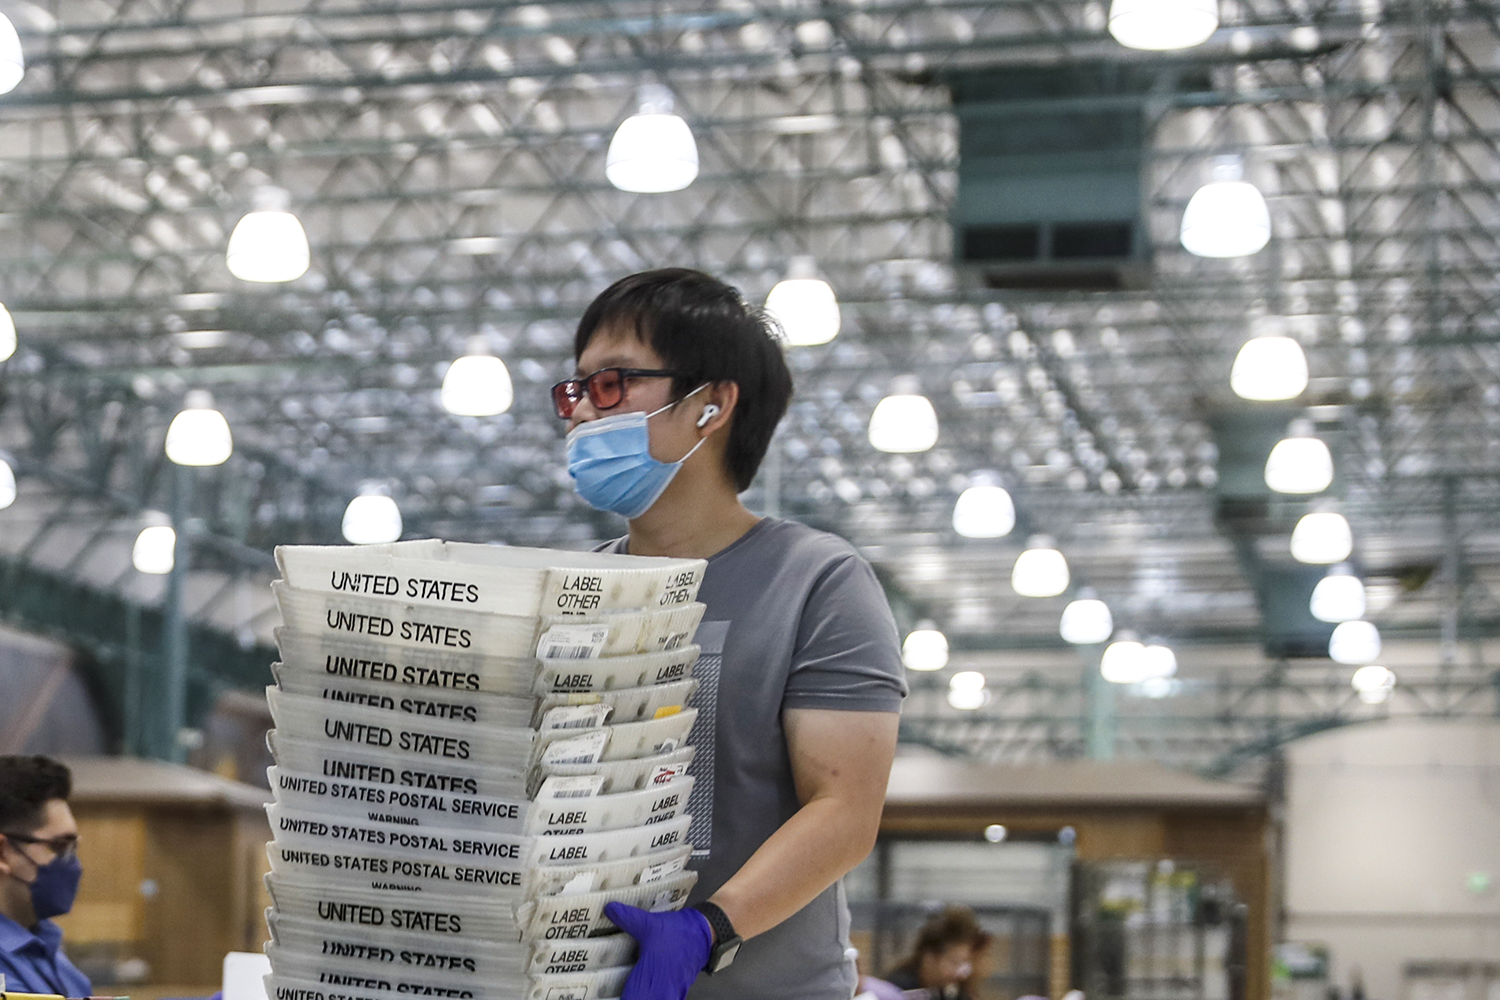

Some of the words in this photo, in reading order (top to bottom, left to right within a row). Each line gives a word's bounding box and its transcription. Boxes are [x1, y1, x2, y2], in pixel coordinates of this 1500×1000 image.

[331, 571, 399, 595] UNITED
[406, 578, 479, 603] STATES
[563, 575, 603, 592] LABEL
[665, 571, 695, 590] LABEL
[557, 594, 601, 609] OTHER
[327, 609, 394, 637] UNITED
[400, 621, 471, 648] STATES
[326, 655, 397, 681] UNITED
[402, 666, 480, 690] STATES
[656, 663, 685, 680] LABEL
[554, 674, 593, 688] LABEL
[324, 718, 392, 747] UNITED
[399, 731, 470, 759] STATES
[323, 759, 395, 784] UNITED
[401, 770, 477, 795] STATES
[279, 775, 327, 795] UNITED
[331, 784, 385, 804] STATES
[388, 792, 447, 812] POSTAL
[452, 799, 519, 819] SERVICE
[651, 794, 680, 813] LABEL
[368, 812, 419, 826] WARNING
[548, 811, 588, 825] LABEL
[280, 817, 328, 836] UNITED
[331, 825, 386, 844] STATES
[389, 833, 448, 852] POSTAL
[452, 840, 520, 859] SERVICE
[651, 830, 680, 848] LABEL
[550, 846, 588, 860] LABEL
[281, 849, 330, 867] UNITED
[334, 855, 388, 874] STATES
[392, 861, 450, 880] POSTAL
[454, 867, 522, 886] SERVICE
[318, 901, 384, 926] UNITED
[390, 909, 462, 933] STATES
[551, 908, 591, 924] LABEL
[545, 924, 588, 940] OTHER
[550, 950, 589, 964] LABEL
